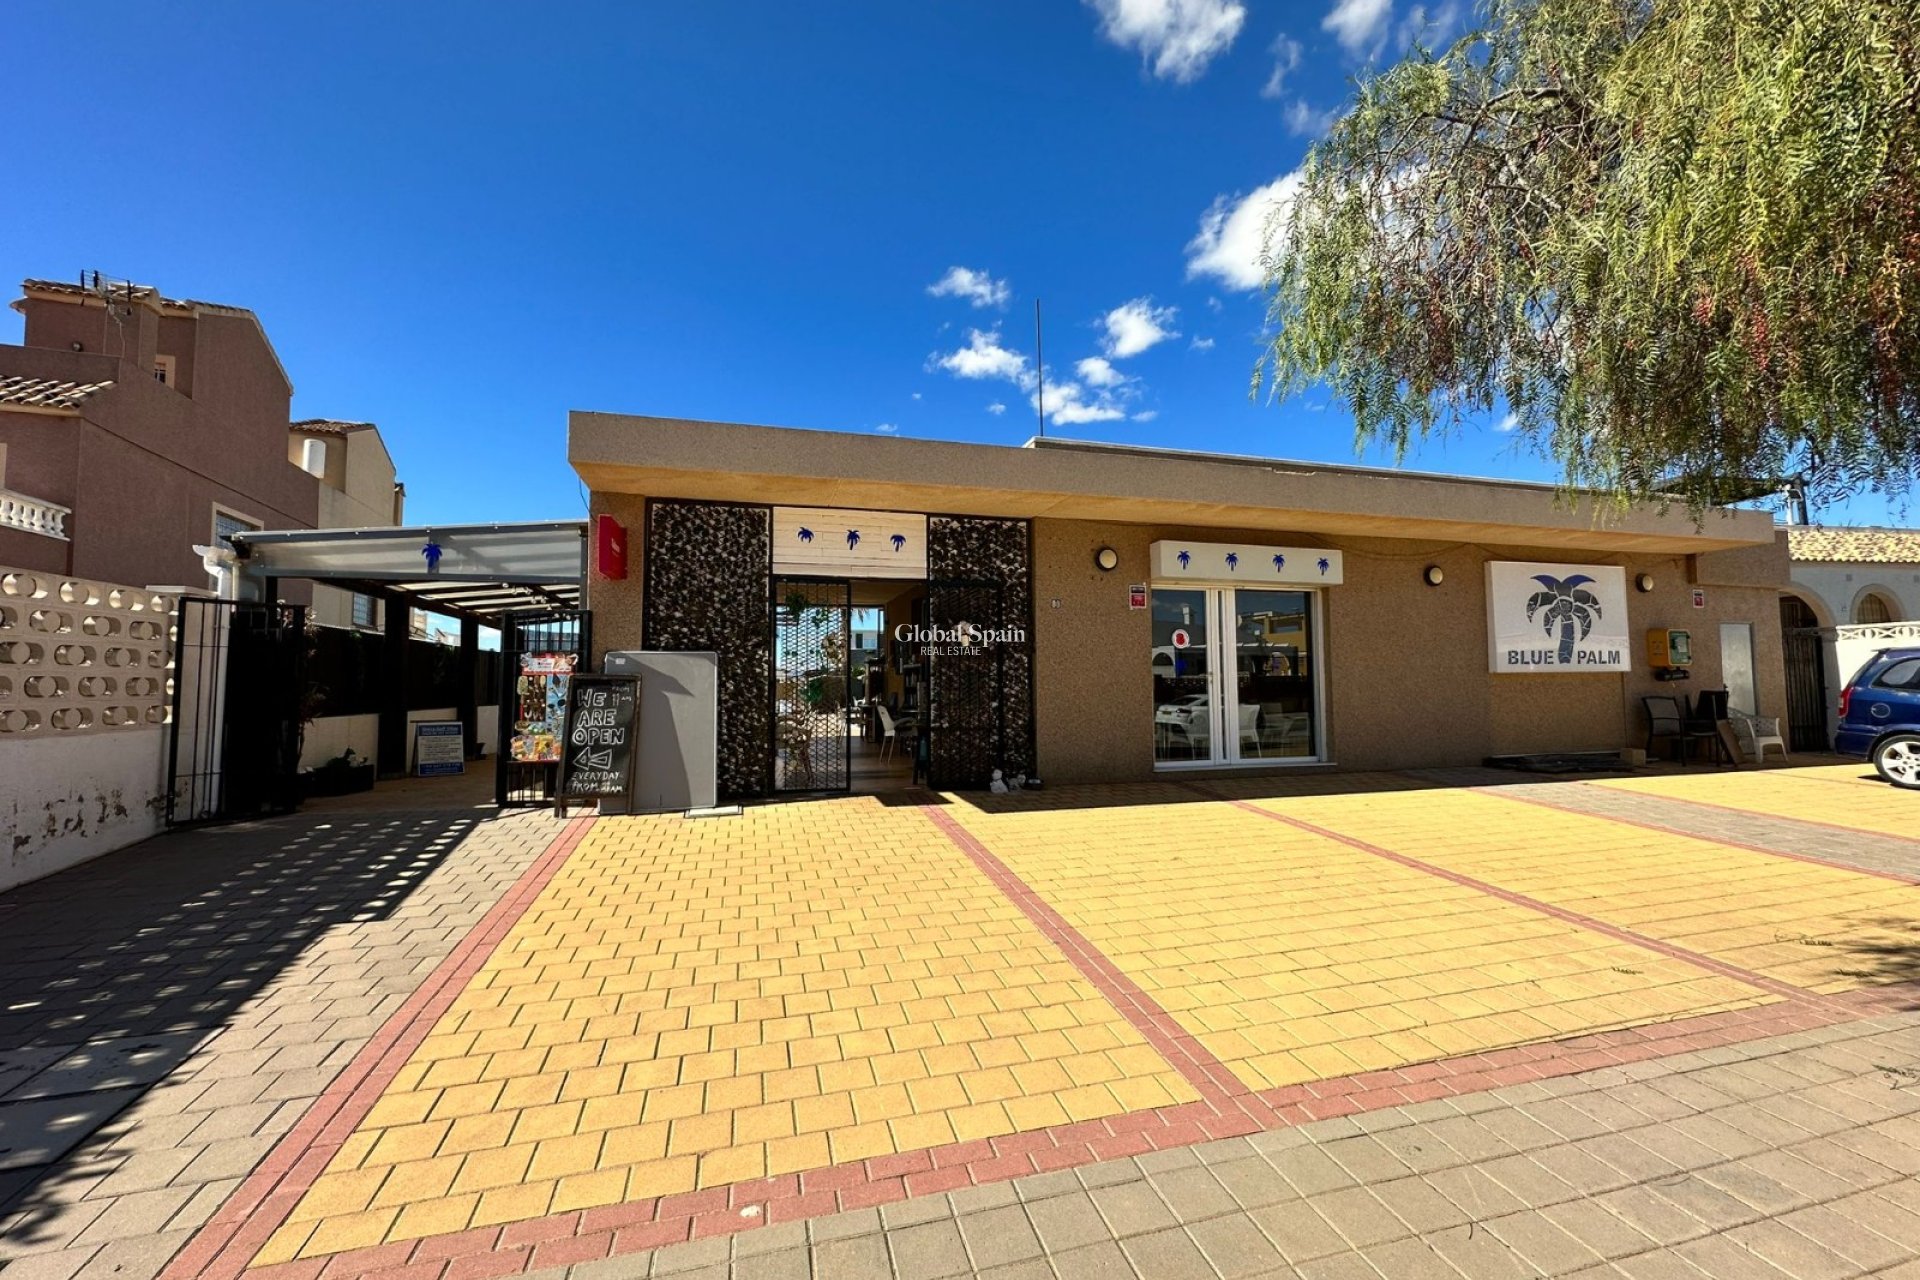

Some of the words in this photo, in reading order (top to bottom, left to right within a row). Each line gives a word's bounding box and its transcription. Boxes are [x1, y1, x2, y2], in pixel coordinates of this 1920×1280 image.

[1507, 650, 1554, 665] BLUE
[1577, 650, 1620, 665] PALM
[576, 688, 607, 708] WE
[576, 709, 617, 727] ARE
[571, 727, 625, 746] OPEN
[571, 771, 621, 781] EVERYDAY
